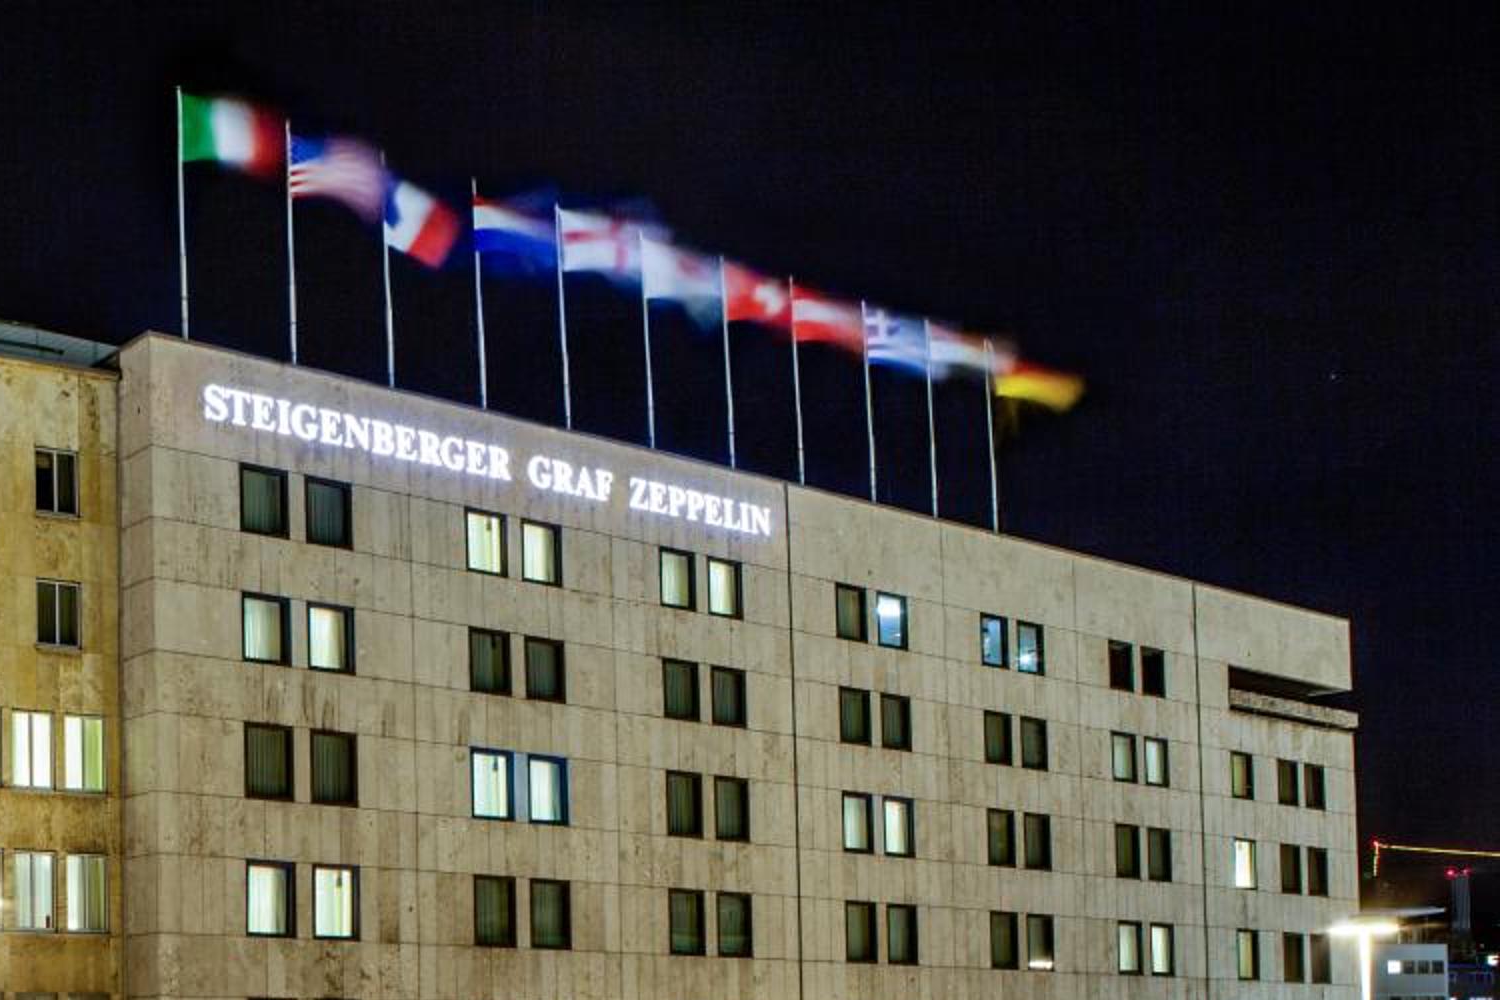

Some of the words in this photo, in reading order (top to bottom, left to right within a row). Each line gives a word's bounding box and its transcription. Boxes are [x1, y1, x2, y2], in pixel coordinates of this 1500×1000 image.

[203, 384, 512, 480] STEIGENBERGER
[527, 455, 613, 501] GRAF
[629, 477, 771, 536] ZEPPELIN
